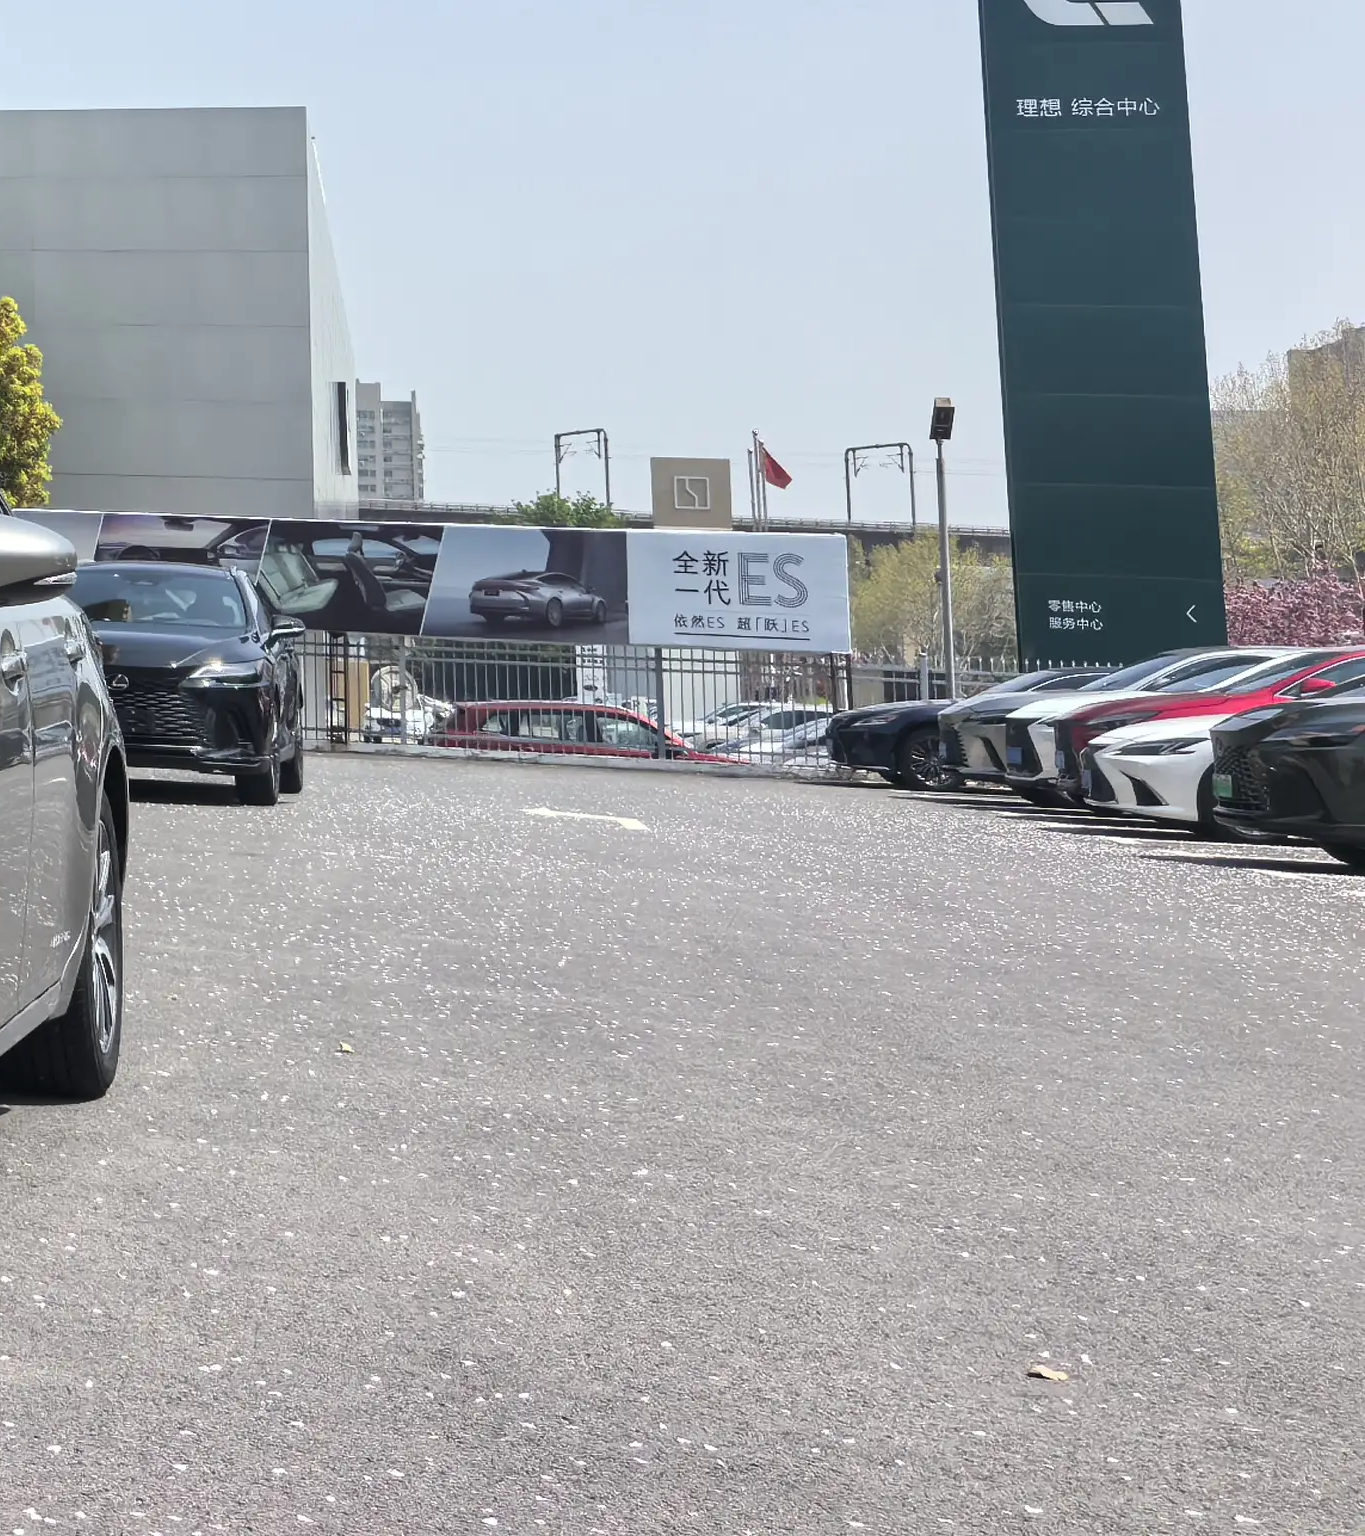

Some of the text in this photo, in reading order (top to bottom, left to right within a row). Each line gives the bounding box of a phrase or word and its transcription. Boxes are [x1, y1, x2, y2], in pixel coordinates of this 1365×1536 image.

[1016, 97, 1160, 117] 理想 综合中心
[672, 549, 729, 577] 全新
[737, 552, 809, 608] ES
[674, 579, 731, 606] 一代
[1048, 599, 1102, 613] 零售中心
[1049, 616, 1103, 631] 服务中心
